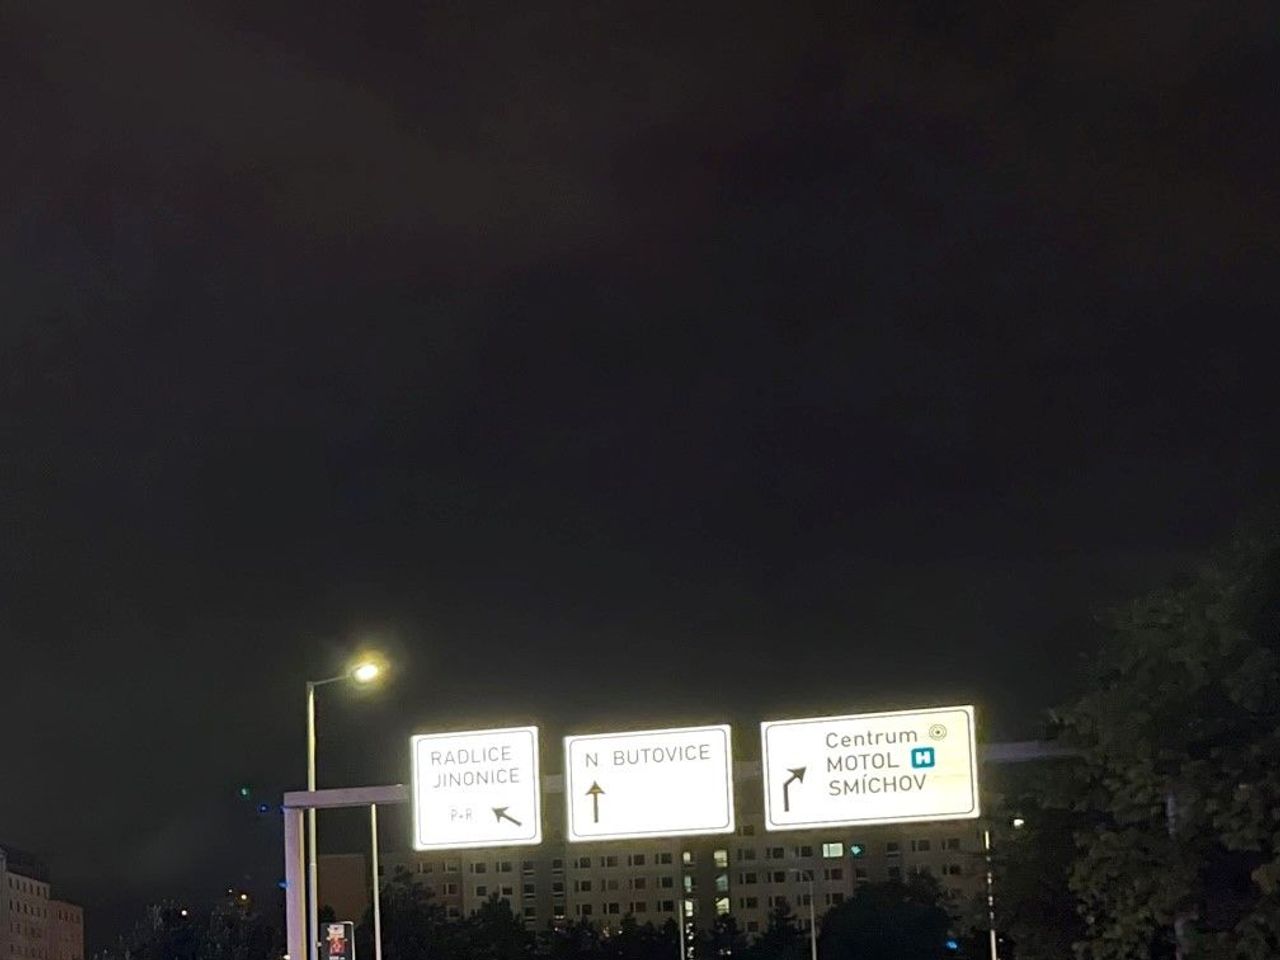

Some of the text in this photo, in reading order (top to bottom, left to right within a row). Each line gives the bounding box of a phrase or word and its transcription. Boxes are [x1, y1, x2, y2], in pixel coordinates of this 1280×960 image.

[825, 730, 918, 748] Centrum
[431, 746, 512, 766] RADLICE
[585, 744, 711, 767] N BUTOVICE
[827, 752, 900, 772] MOTOL
[433, 768, 520, 788] JINONICE
[829, 774, 926, 796] SMÍCHOV
